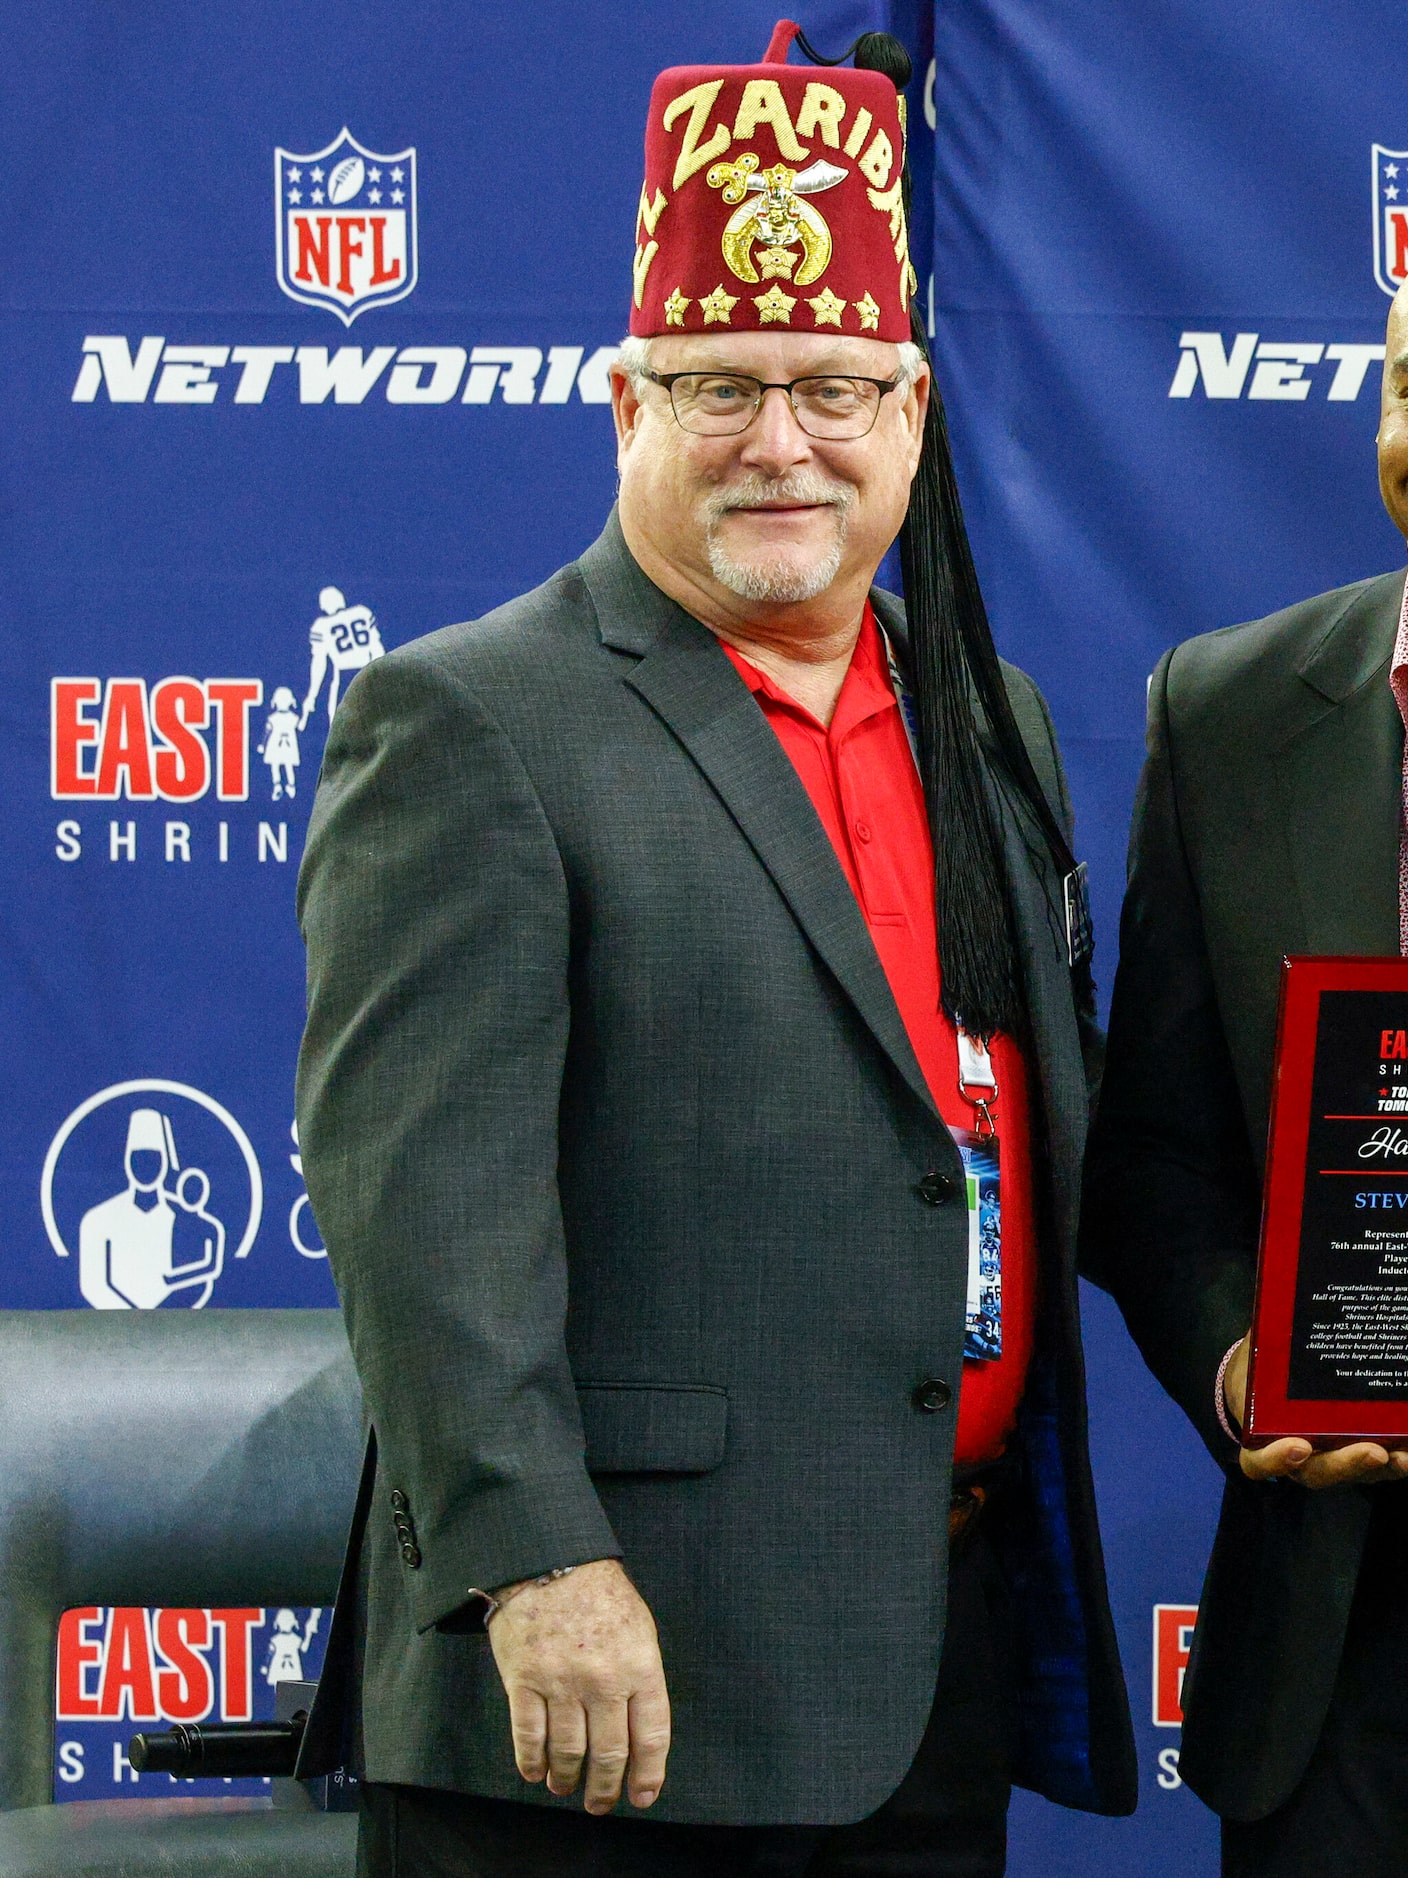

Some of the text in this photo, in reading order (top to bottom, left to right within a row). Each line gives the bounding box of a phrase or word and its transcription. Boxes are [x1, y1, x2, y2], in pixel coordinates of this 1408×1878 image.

[294, 216, 401, 287] NFL
[72, 336, 620, 404] NETWORK
[331, 617, 371, 654] 26
[51, 676, 263, 803] EAST
[55, 819, 289, 863] SHRIN
[1352, 1242, 1383, 1250] annual
[56, 1607, 266, 1723] EAST
